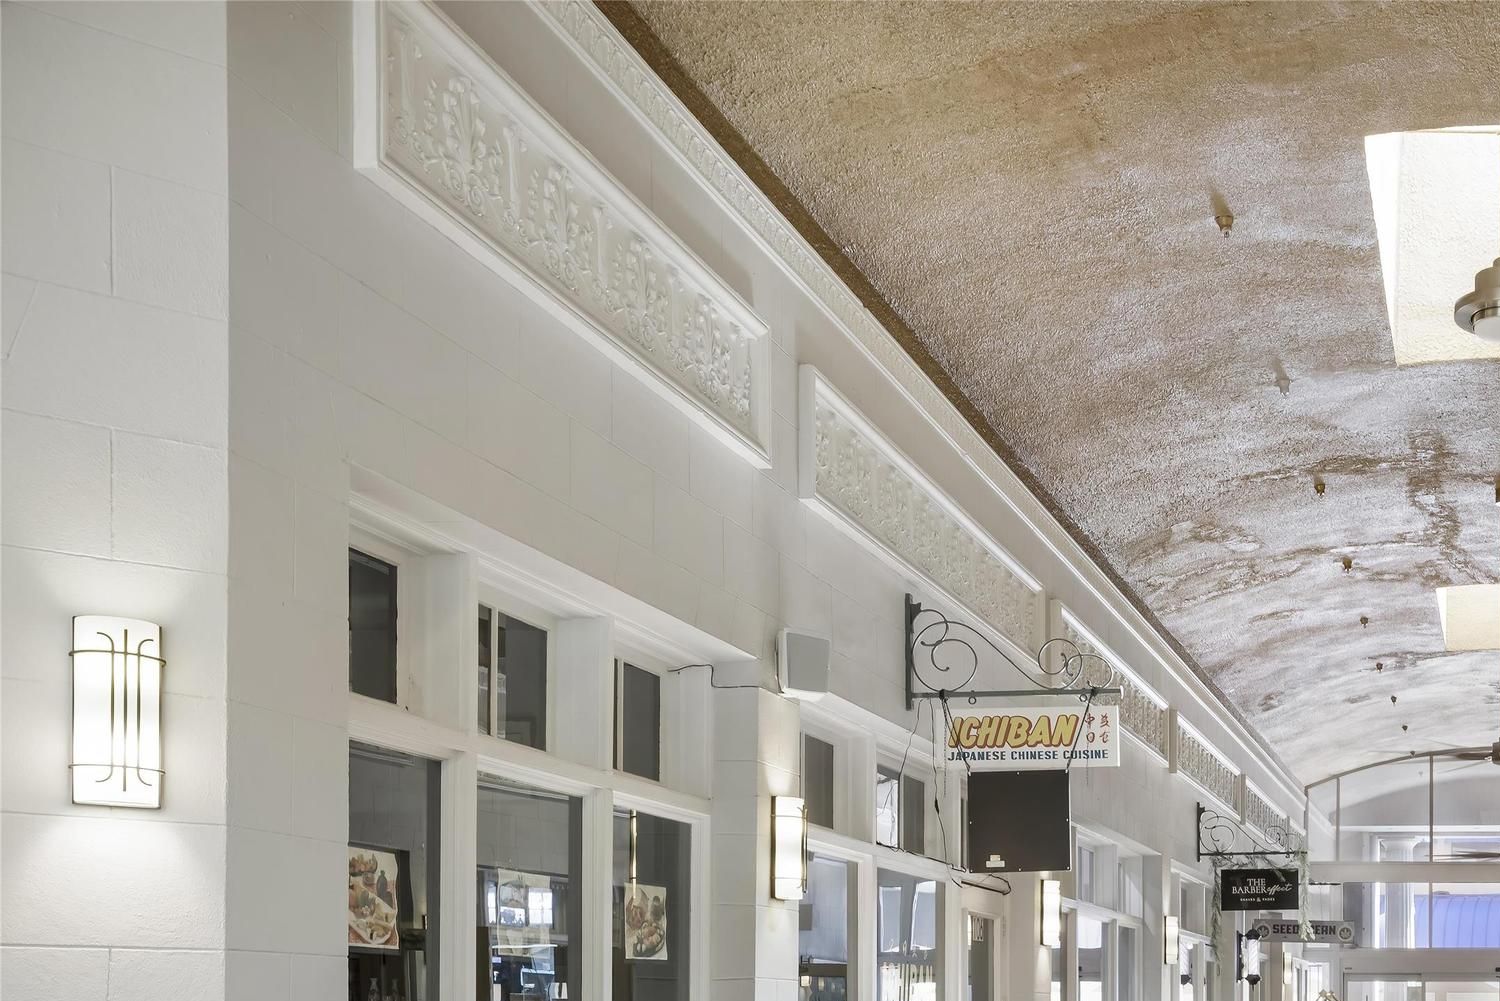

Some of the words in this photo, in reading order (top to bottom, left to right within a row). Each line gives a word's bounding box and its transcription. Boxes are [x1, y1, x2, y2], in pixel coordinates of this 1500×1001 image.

[948, 714, 1079, 749] ICHIBAN
[948, 751, 1006, 761] JAPANESE
[1011, 751, 1059, 761] CHINESE
[1063, 750, 1109, 760] CUISINE
[1246, 878, 1266, 886] THE
[1232, 885, 1267, 894] BARBER
[1267, 883, 1293, 895] effect
[1272, 924, 1299, 935] SEED
